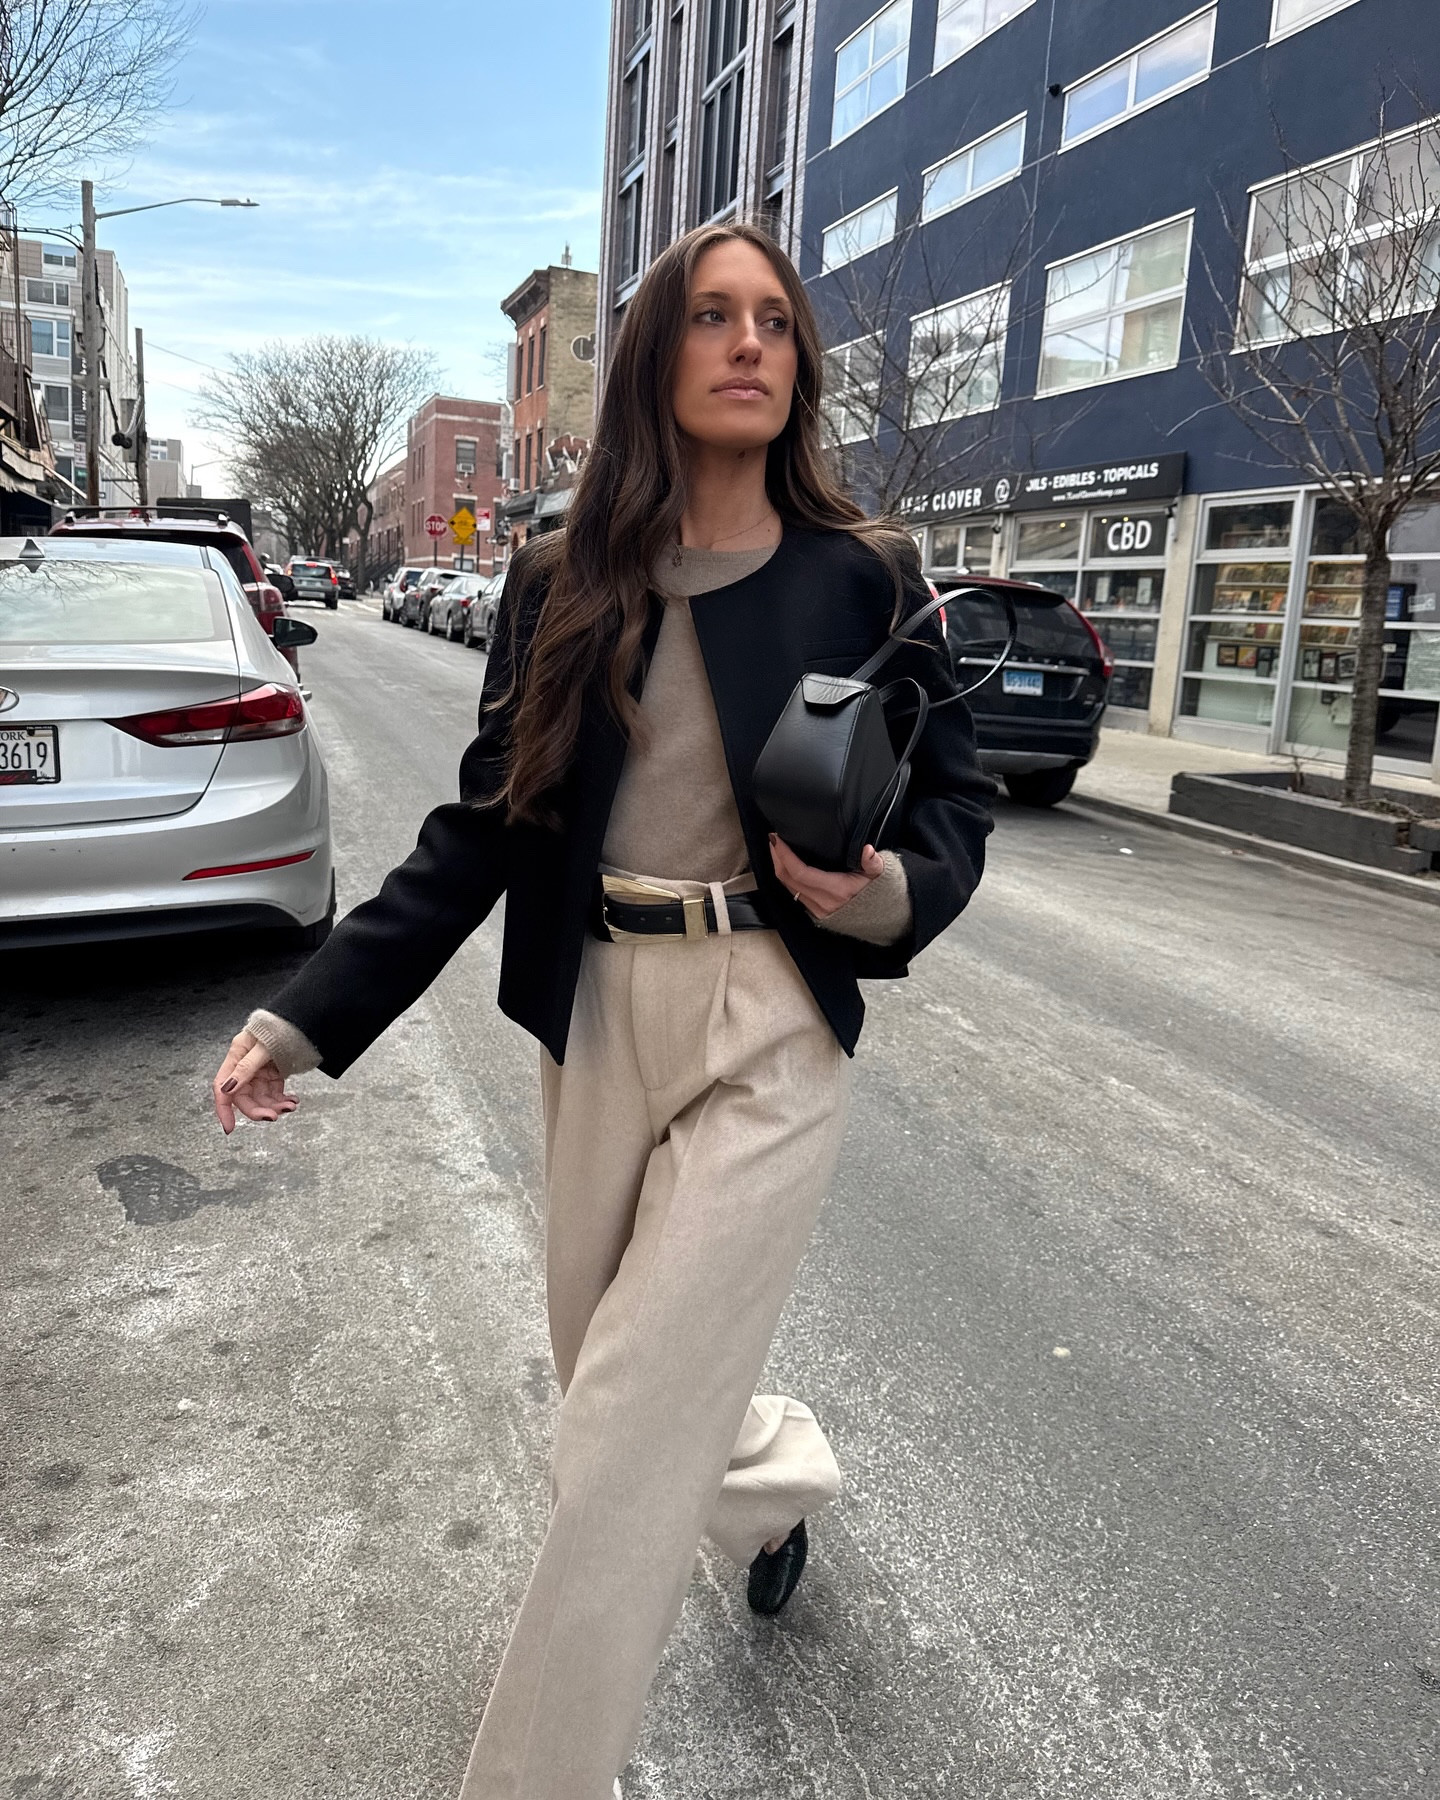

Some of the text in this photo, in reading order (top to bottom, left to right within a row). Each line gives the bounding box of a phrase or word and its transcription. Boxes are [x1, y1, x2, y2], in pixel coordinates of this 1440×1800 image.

[1052, 471, 1096, 489] EDIBLES
[1103, 462, 1159, 483] TOPICALS
[932, 487, 982, 512] CLOVER
[425, 521, 447, 532] STOP
[1107, 520, 1151, 550] CBD
[0, 731, 26, 741] ORK
[0, 742, 47, 769] 3619
